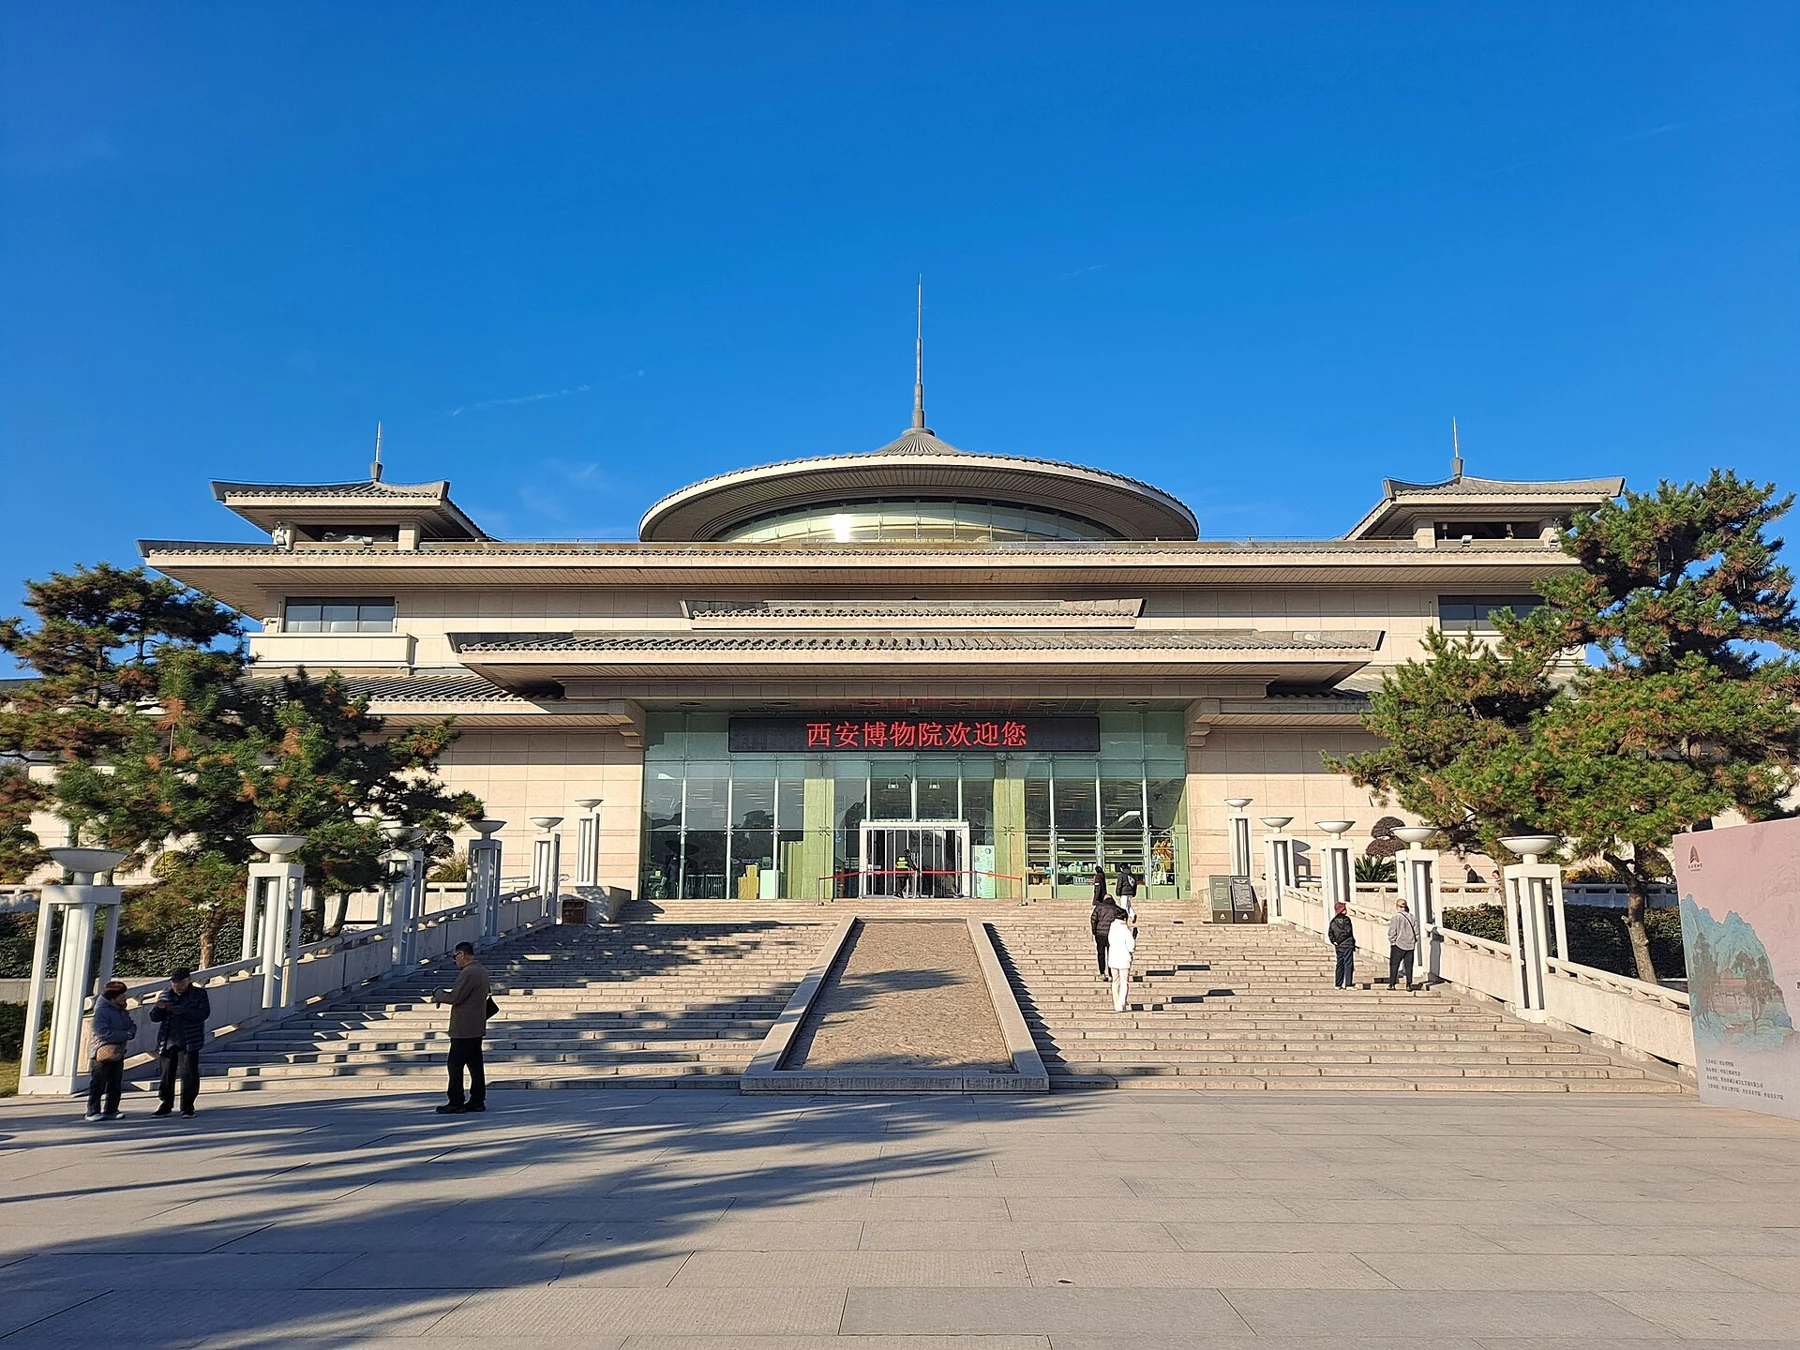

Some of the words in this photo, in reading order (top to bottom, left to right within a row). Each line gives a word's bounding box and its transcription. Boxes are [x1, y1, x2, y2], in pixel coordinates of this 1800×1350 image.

[806, 721, 1027, 747] 西安博物院欢迎您
